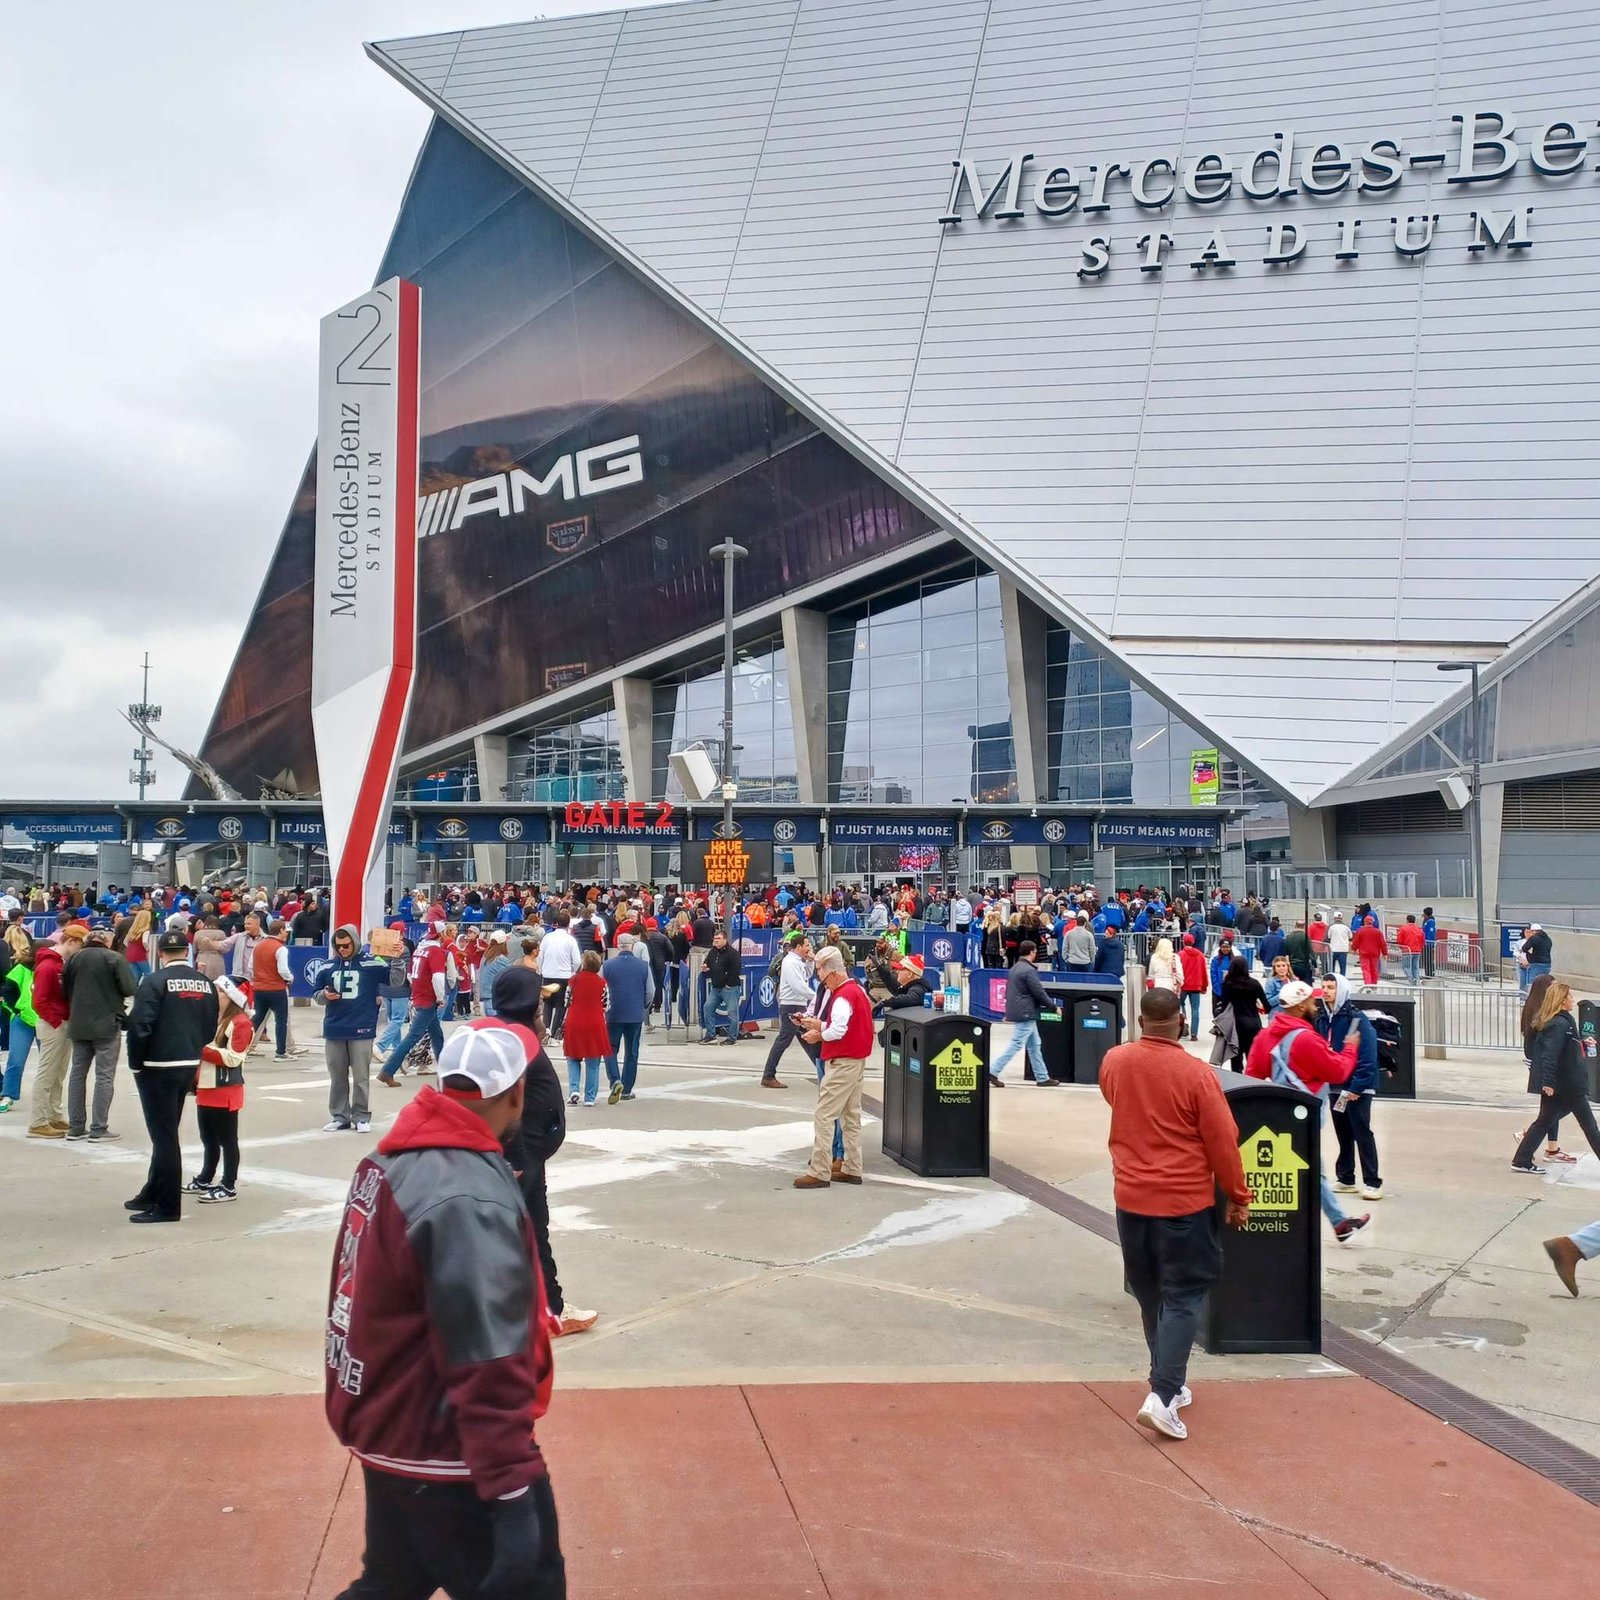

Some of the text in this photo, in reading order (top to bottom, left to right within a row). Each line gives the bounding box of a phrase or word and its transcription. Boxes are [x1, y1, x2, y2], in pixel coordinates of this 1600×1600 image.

[938, 110, 1600, 224] Mercedes-Be
[1076, 207, 1534, 278] STADIUM
[336, 291, 392, 386] 2
[330, 402, 361, 618] Mercedes-Benz
[365, 450, 383, 571] STADIUM
[565, 800, 673, 828] GATE 2
[24, 824, 114, 833] ACCESSIBILITY LANE
[162, 823, 178, 837] SEC
[221, 818, 240, 838] SEC
[281, 823, 292, 833] IT
[293, 823, 322, 834] JUST
[445, 823, 460, 835] SEC
[502, 820, 521, 838] SEC
[562, 824, 571, 833] IT
[574, 823, 601, 834] JUST
[603, 824, 642, 835] MEANS
[776, 822, 794, 839] SEC
[835, 824, 846, 834] IT
[847, 824, 873, 835] JUST
[875, 825, 914, 836] MEANS
[990, 824, 1005, 837] SEC
[1045, 822, 1064, 840] SEC
[1108, 825, 1136, 836] JUST
[1138, 826, 1176, 837] MEANS
[711, 840, 742, 855] HAVE
[704, 854, 750, 869] TICKET
[707, 869, 745, 883] READY
[933, 942, 952, 959] SEC
[167, 979, 213, 995] GEORGIA
[331, 970, 360, 1000] 13
[760, 977, 774, 1005] SEC
[939, 1066, 974, 1077] RECYCLE
[939, 1077, 974, 1087] FOR GOOD
[939, 1095, 971, 1104] Novelis
[1246, 1172, 1293, 1189] ECYCLE
[1262, 1190, 1293, 1204] GOOD
[1238, 1219, 1290, 1233] Novelis
